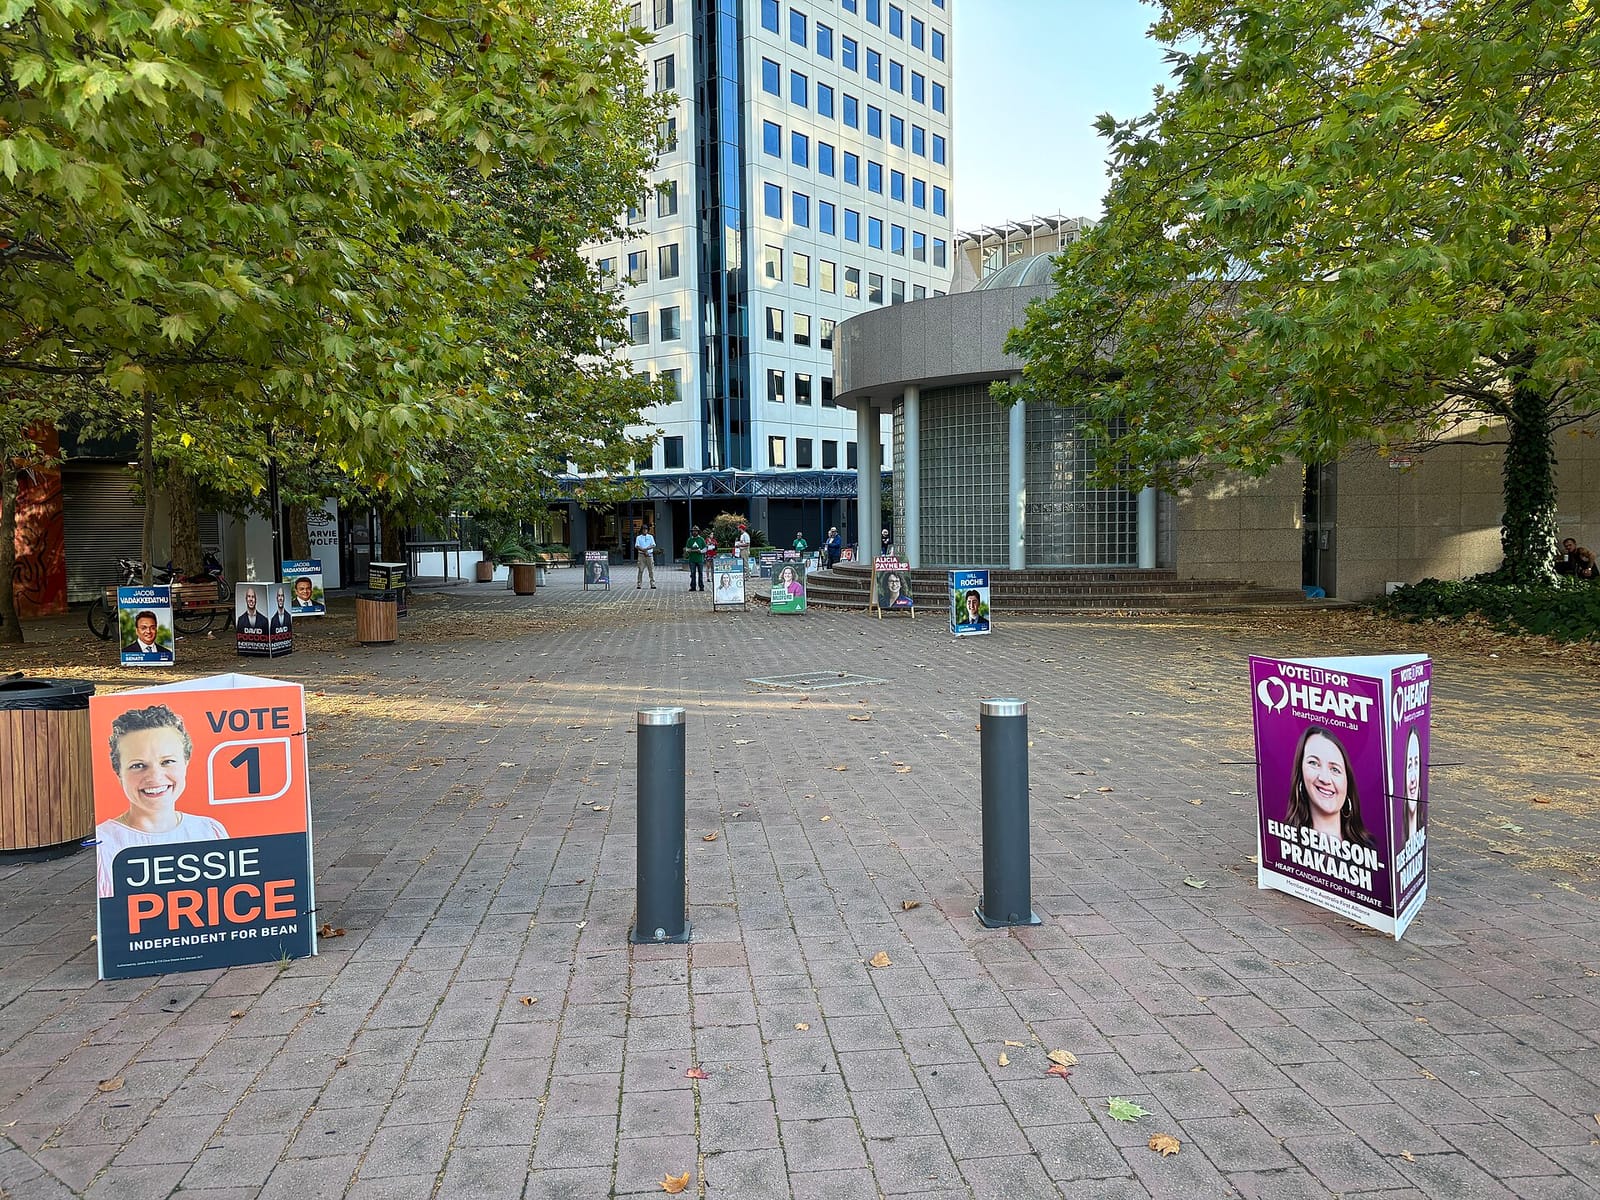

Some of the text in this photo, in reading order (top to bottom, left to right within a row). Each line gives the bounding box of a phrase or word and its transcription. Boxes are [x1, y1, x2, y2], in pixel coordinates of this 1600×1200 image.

[1278, 664, 1310, 680] VOTE
[1325, 672, 1348, 687] FOR
[1290, 682, 1374, 722] HEART
[1404, 679, 1430, 712] HEART
[206, 706, 290, 733] VOTE
[1292, 708, 1358, 730] heartparty.com.au
[230, 746, 260, 794] 1
[1268, 819, 1384, 872] ELISE SEARSON-
[126, 848, 260, 887] JESSIE
[1275, 862, 1383, 907] HEART CANDIDATE FOR THE SENATE
[1280, 840, 1372, 892] PRAKAASH
[127, 878, 297, 935] PRICE
[129, 924, 297, 952] INDEPENDENT FOR BEAN
